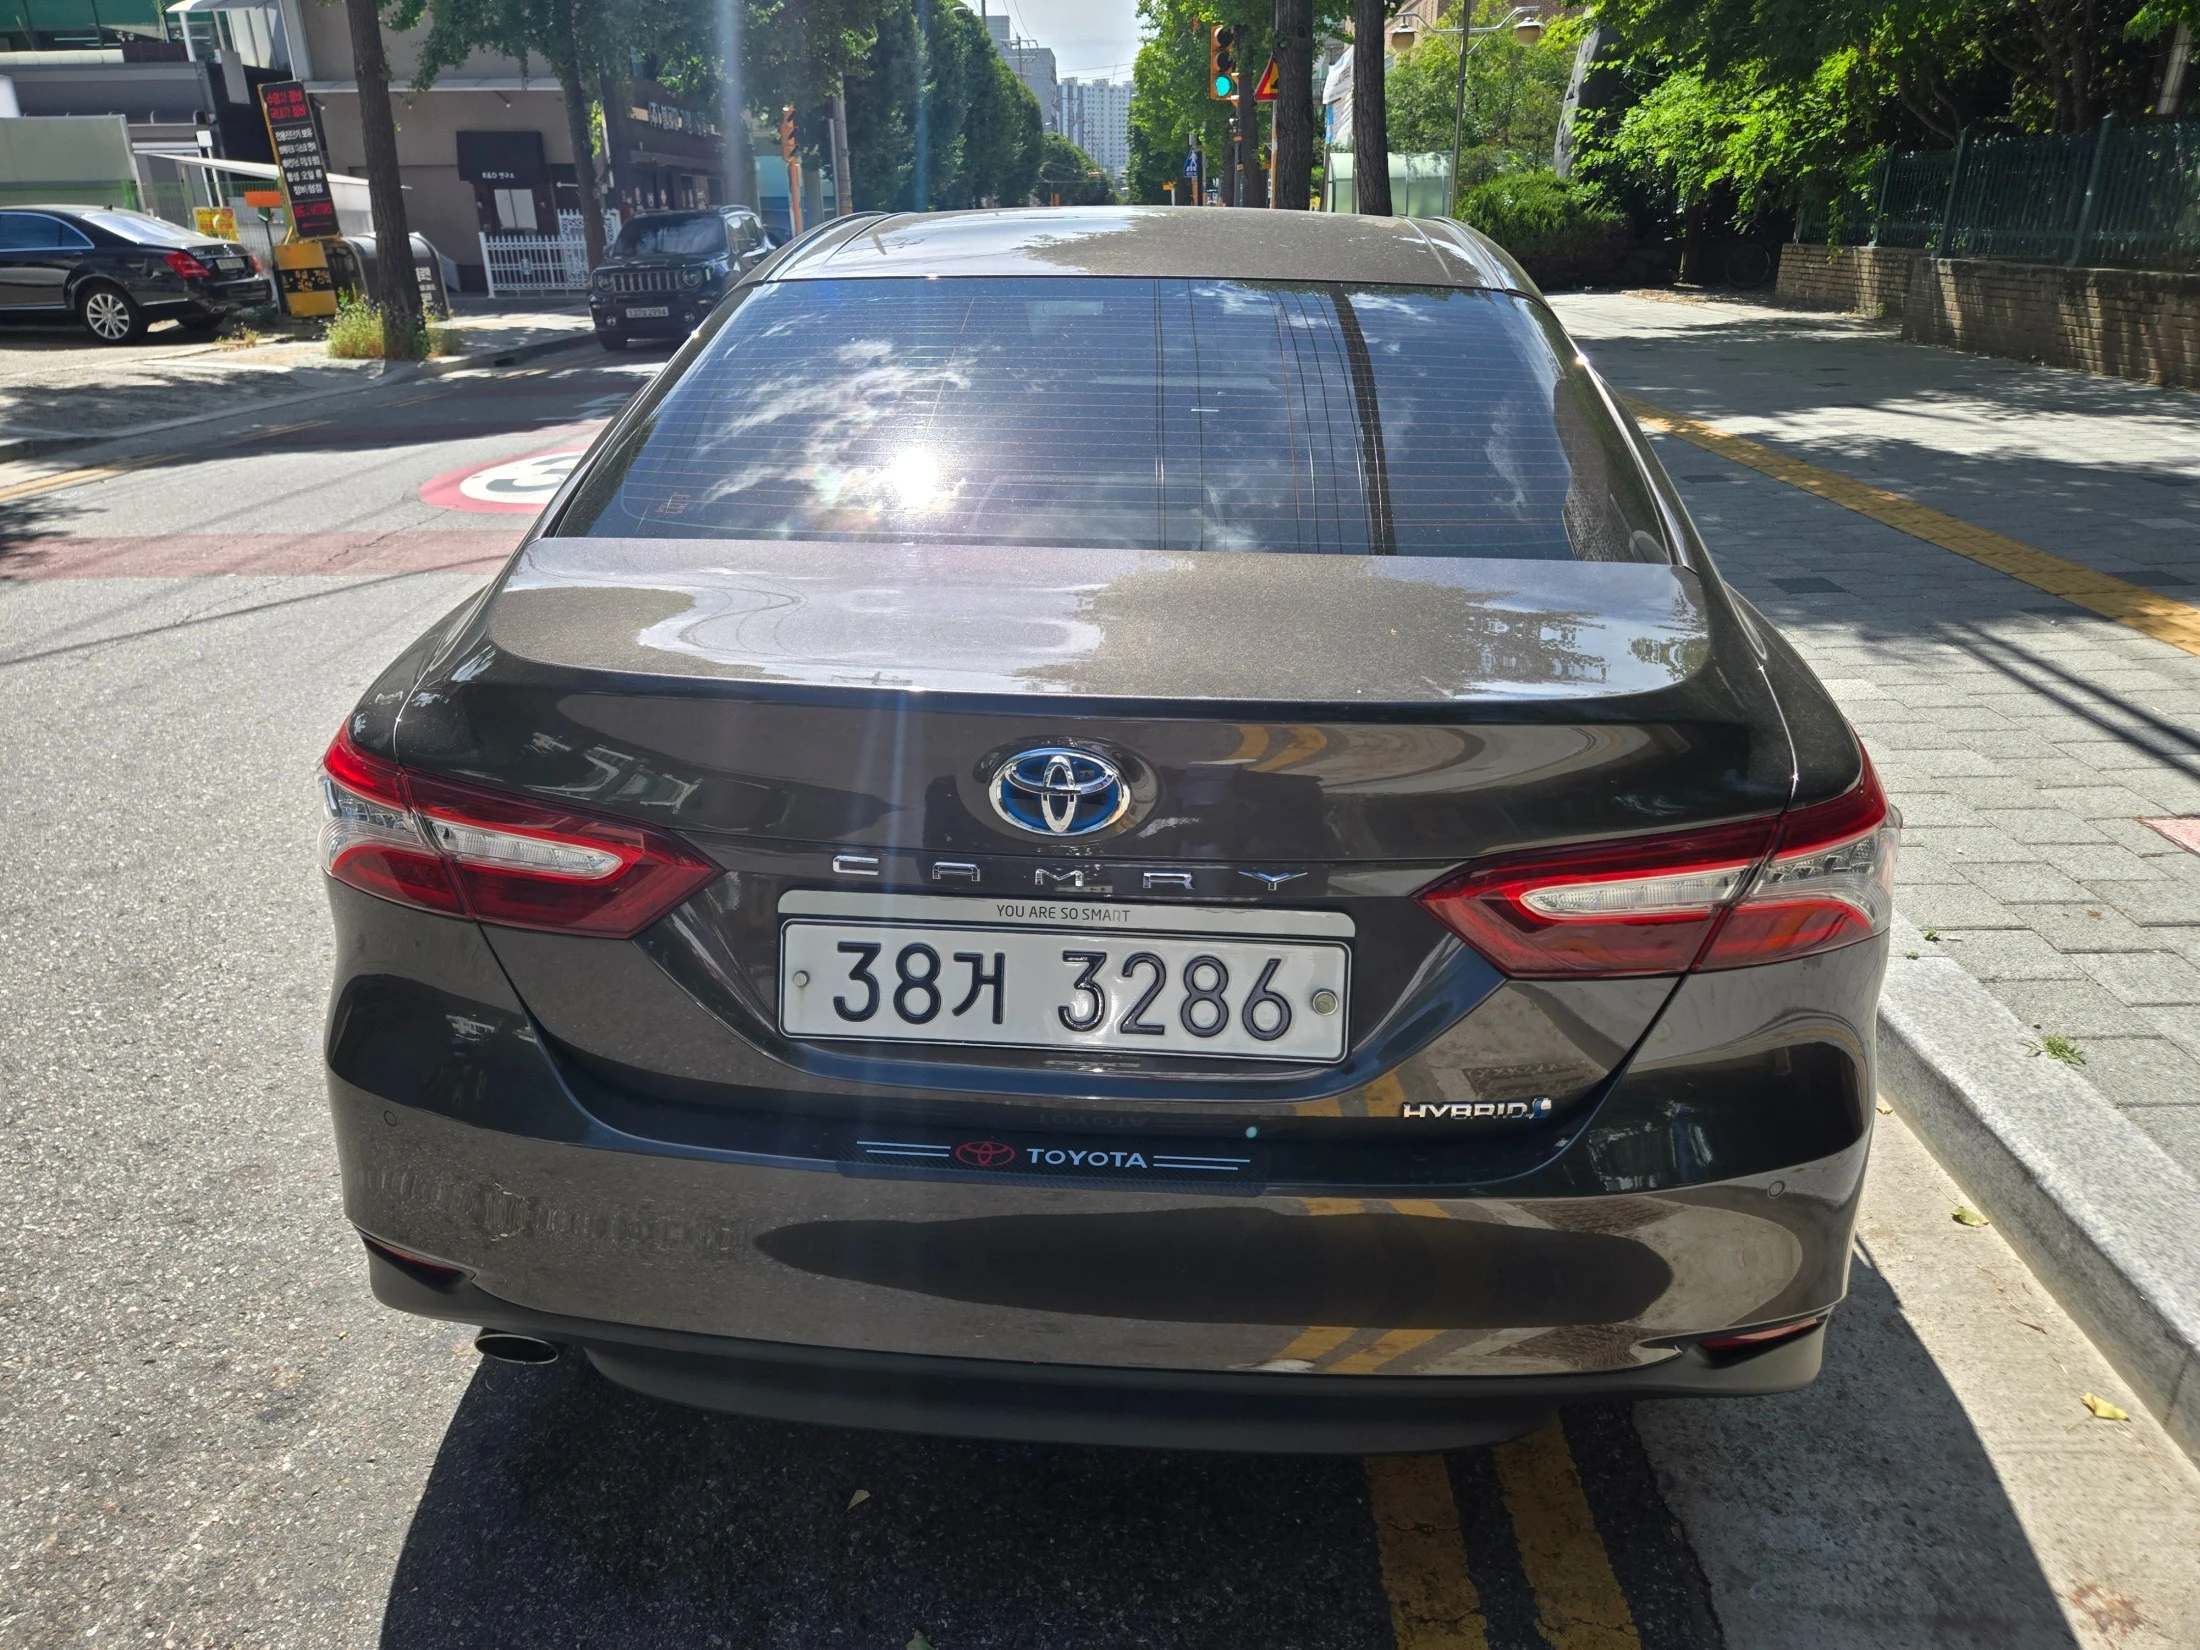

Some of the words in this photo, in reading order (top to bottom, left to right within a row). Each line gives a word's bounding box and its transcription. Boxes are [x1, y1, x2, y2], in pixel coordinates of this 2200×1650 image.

[832, 854, 1308, 892] CAMRY
[996, 904, 1025, 918] YOU
[1029, 906, 1057, 920] ARE
[1060, 907, 1079, 920] SO
[1082, 908, 1131, 923] SMART
[832, 940, 1005, 1025] 38거
[1057, 950, 1294, 1041] 3286
[1403, 1103, 1528, 1120] HYBRID
[1026, 1148, 1148, 1169] TOYOTA
